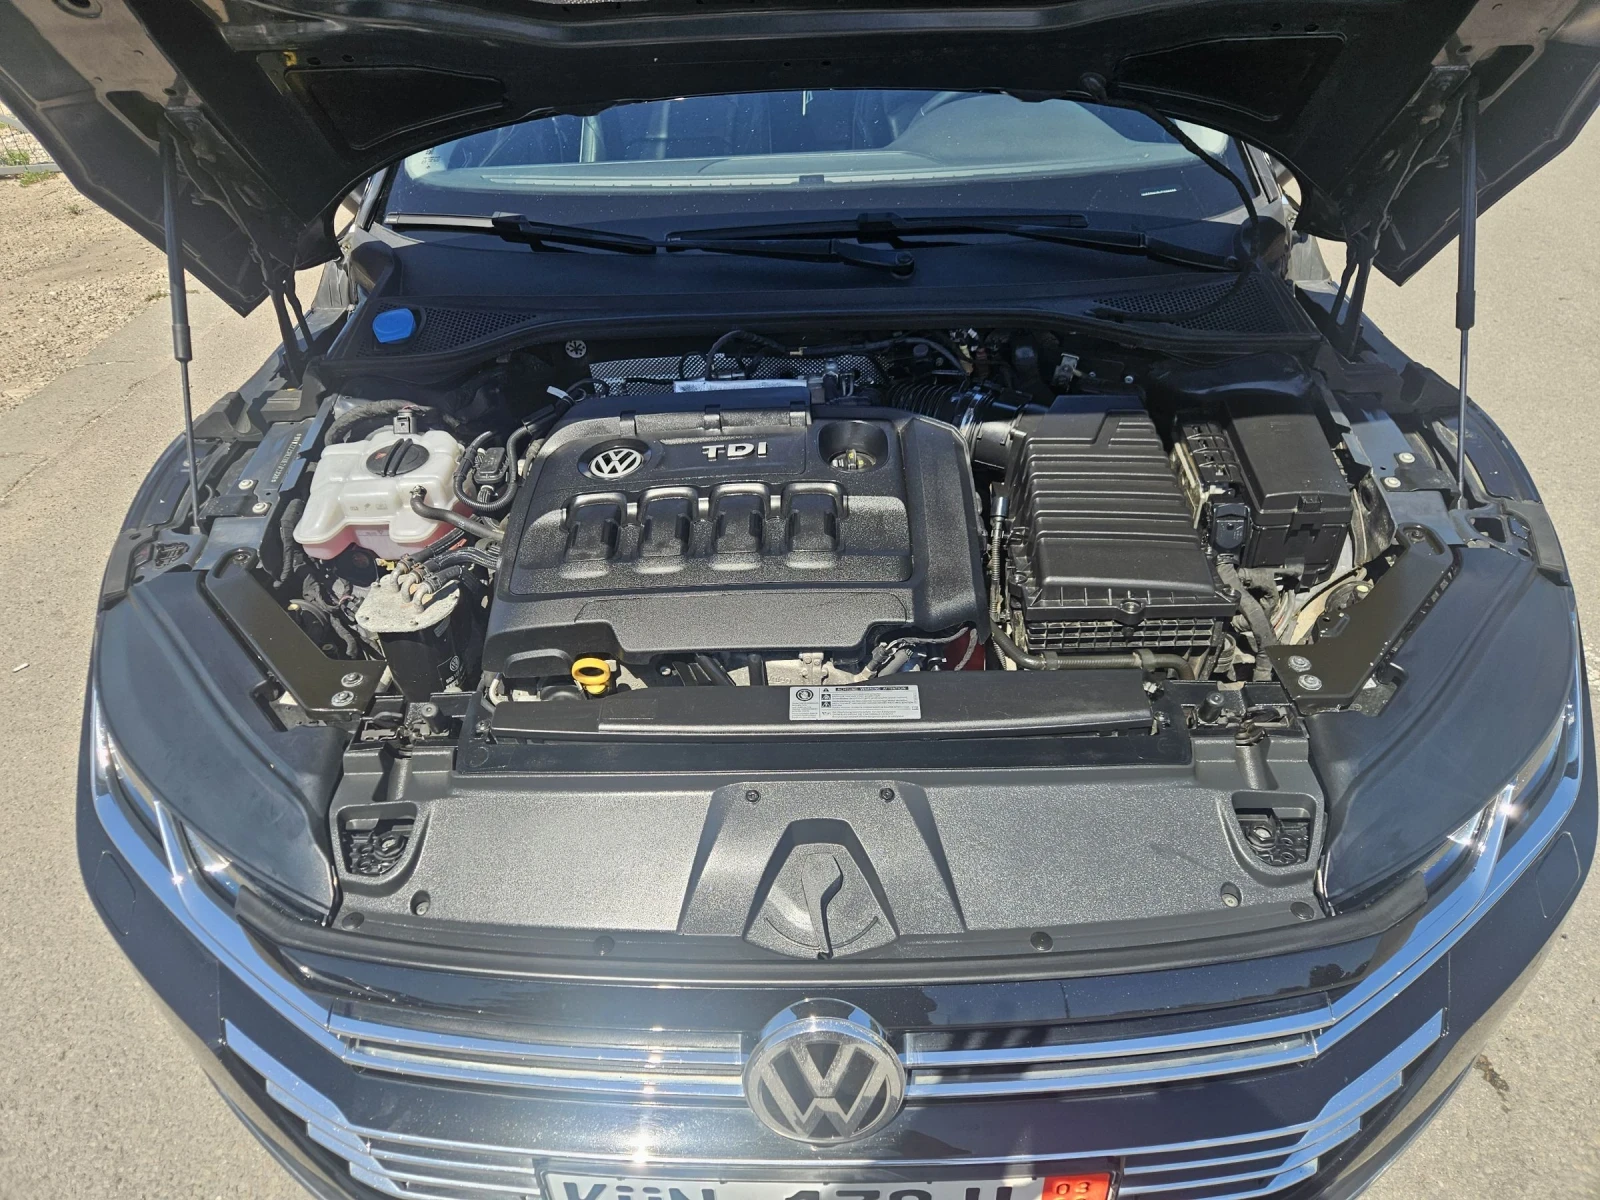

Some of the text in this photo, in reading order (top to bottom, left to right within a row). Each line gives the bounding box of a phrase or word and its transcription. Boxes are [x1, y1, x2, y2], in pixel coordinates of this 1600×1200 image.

[702, 441, 767, 460] TDI
[590, 448, 642, 478] VW
[748, 1028, 902, 1142] VW
[1056, 1181, 1090, 1195] 03
